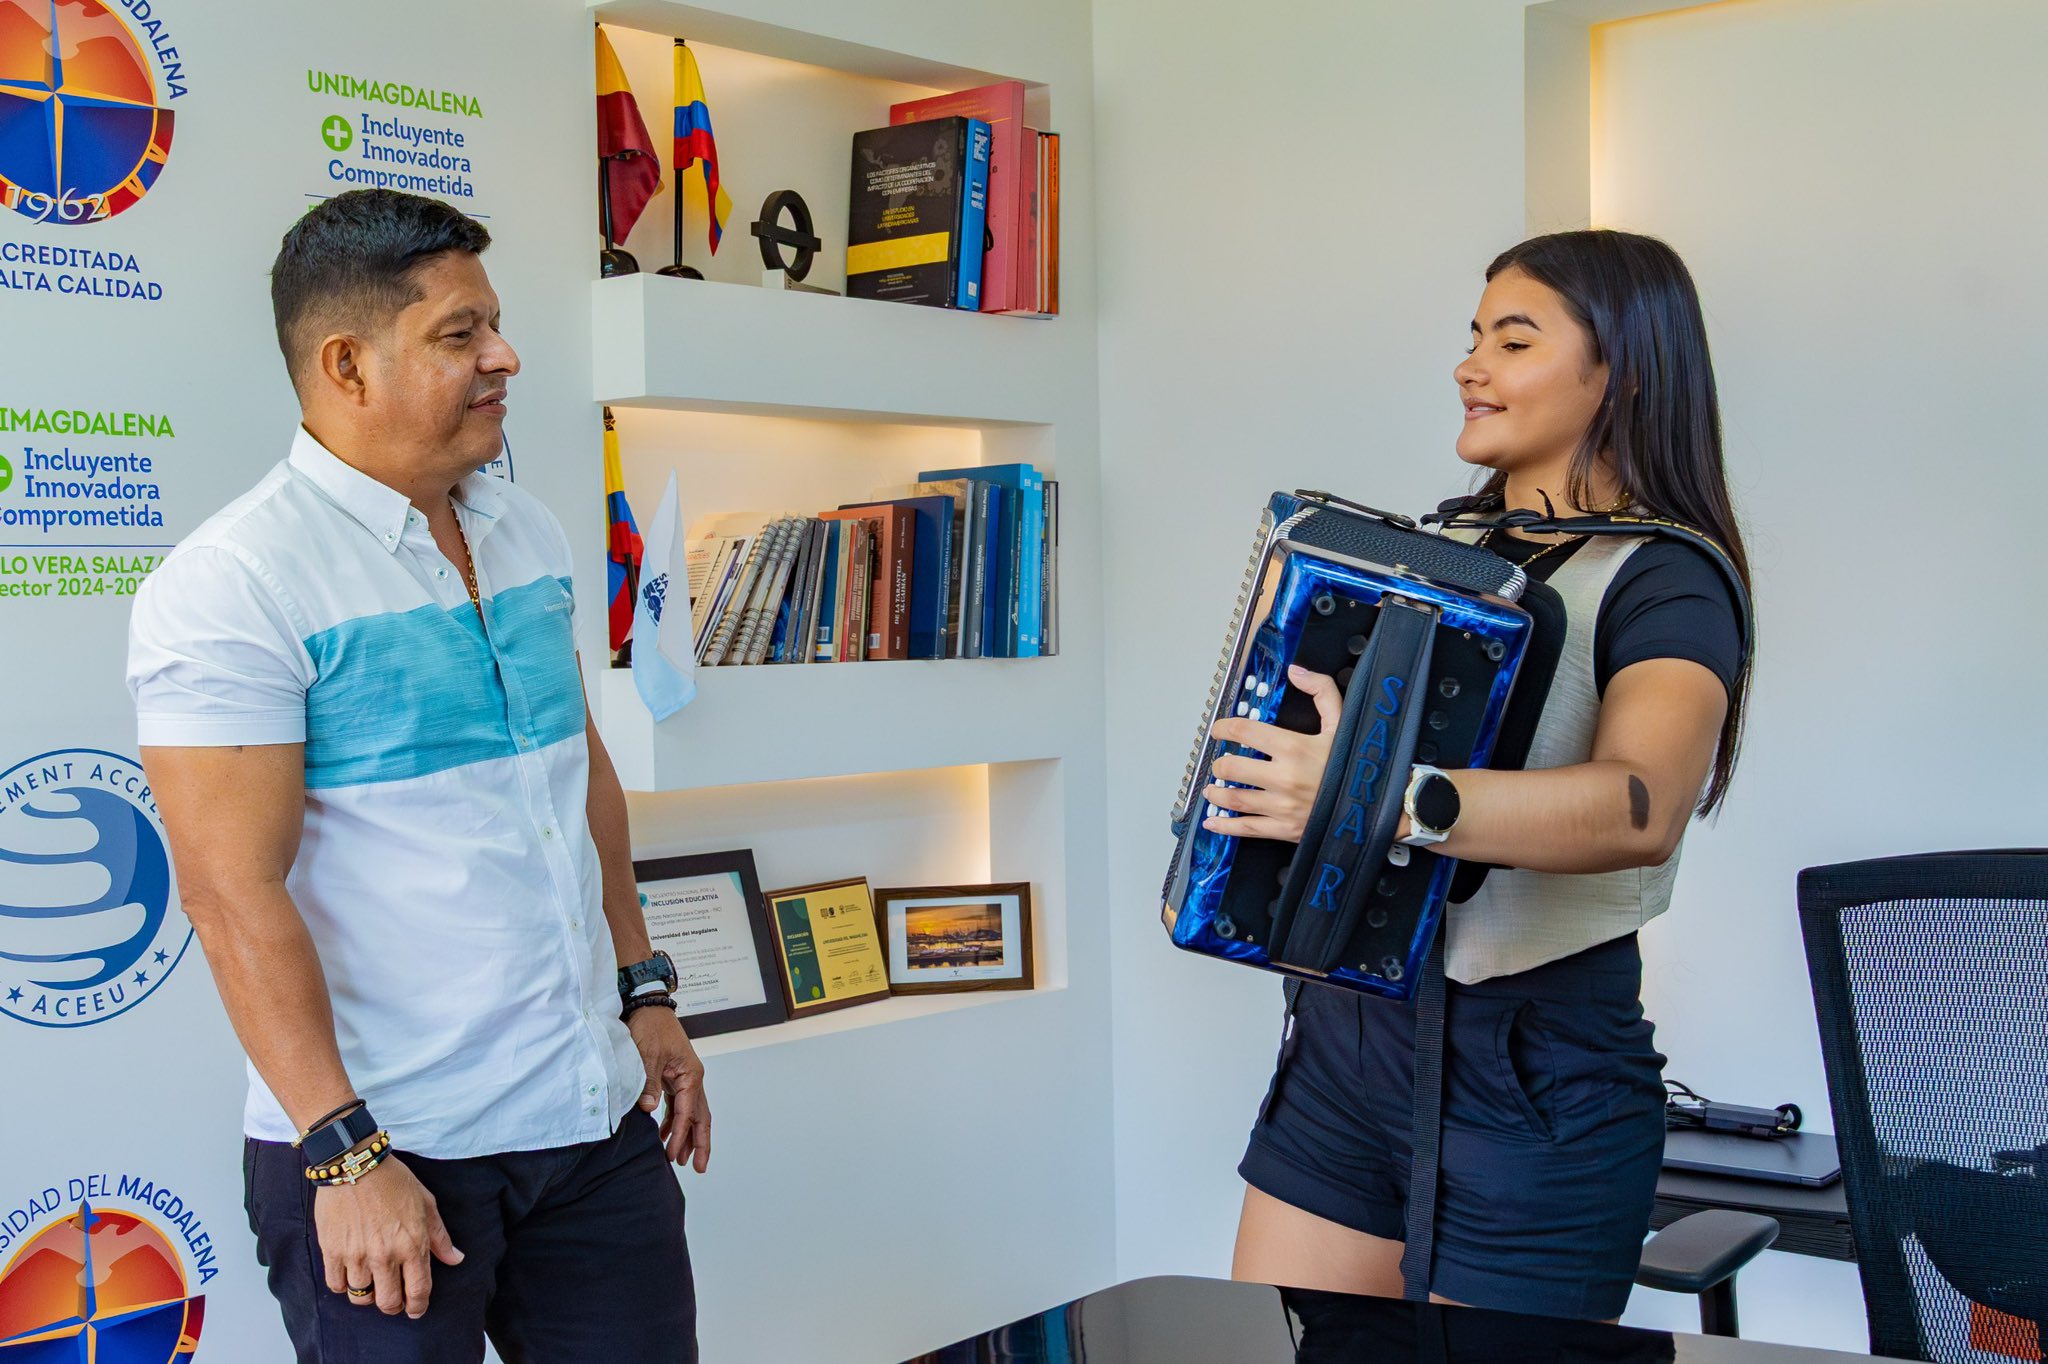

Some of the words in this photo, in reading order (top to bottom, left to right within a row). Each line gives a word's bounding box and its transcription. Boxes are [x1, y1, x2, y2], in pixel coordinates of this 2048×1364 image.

[307, 69, 483, 118] UNIMAGDALENA
[361, 113, 464, 147] Incluyente
[361, 138, 471, 173] Innovadora
[328, 159, 474, 197] Comprometida
[7, 186, 110, 225] 1962
[0, 242, 140, 273] CREDITADA
[57, 274, 163, 301] CALIDAD
[24, 447, 152, 478] Incluyente
[25, 475, 160, 500] Innovadora
[0, 504, 164, 533] omprometida
[32, 555, 88, 575] VERA
[1334, 676, 1404, 845] SARA
[651, 897, 685, 907] INCLUSIÓN
[685, 894, 719, 903] EDUCATIVA
[1309, 863, 1345, 912] R
[651, 932, 681, 941] Universidad
[691, 927, 718, 937] Magdalena
[32, 983, 125, 1017] ACEEU
[68, 1174, 111, 1202] DEL
[117, 1174, 219, 1286] MAGDALENA
